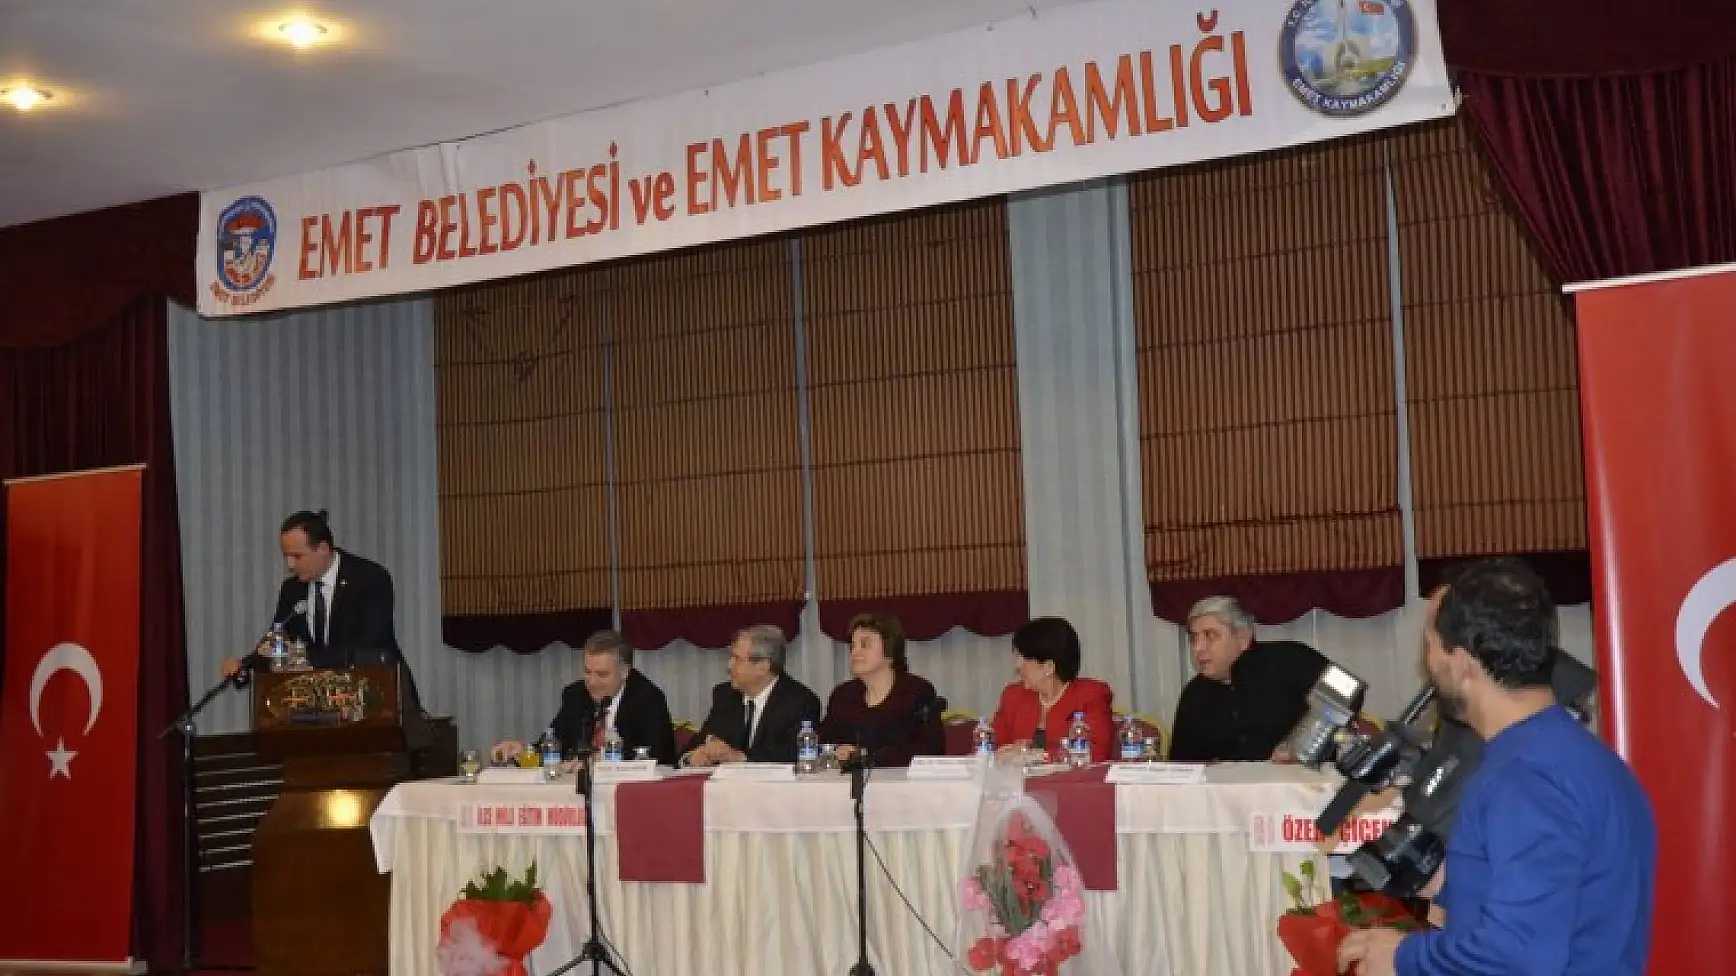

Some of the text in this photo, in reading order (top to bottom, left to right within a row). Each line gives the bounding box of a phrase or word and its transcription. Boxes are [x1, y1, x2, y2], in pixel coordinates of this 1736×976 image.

[298, 204, 401, 281] EMET
[412, 141, 620, 265] BELEDİYESİ
[628, 172, 676, 226] ve
[686, 122, 810, 216] EMET
[820, 9, 1253, 192] KAYMAKAMLIĞI
